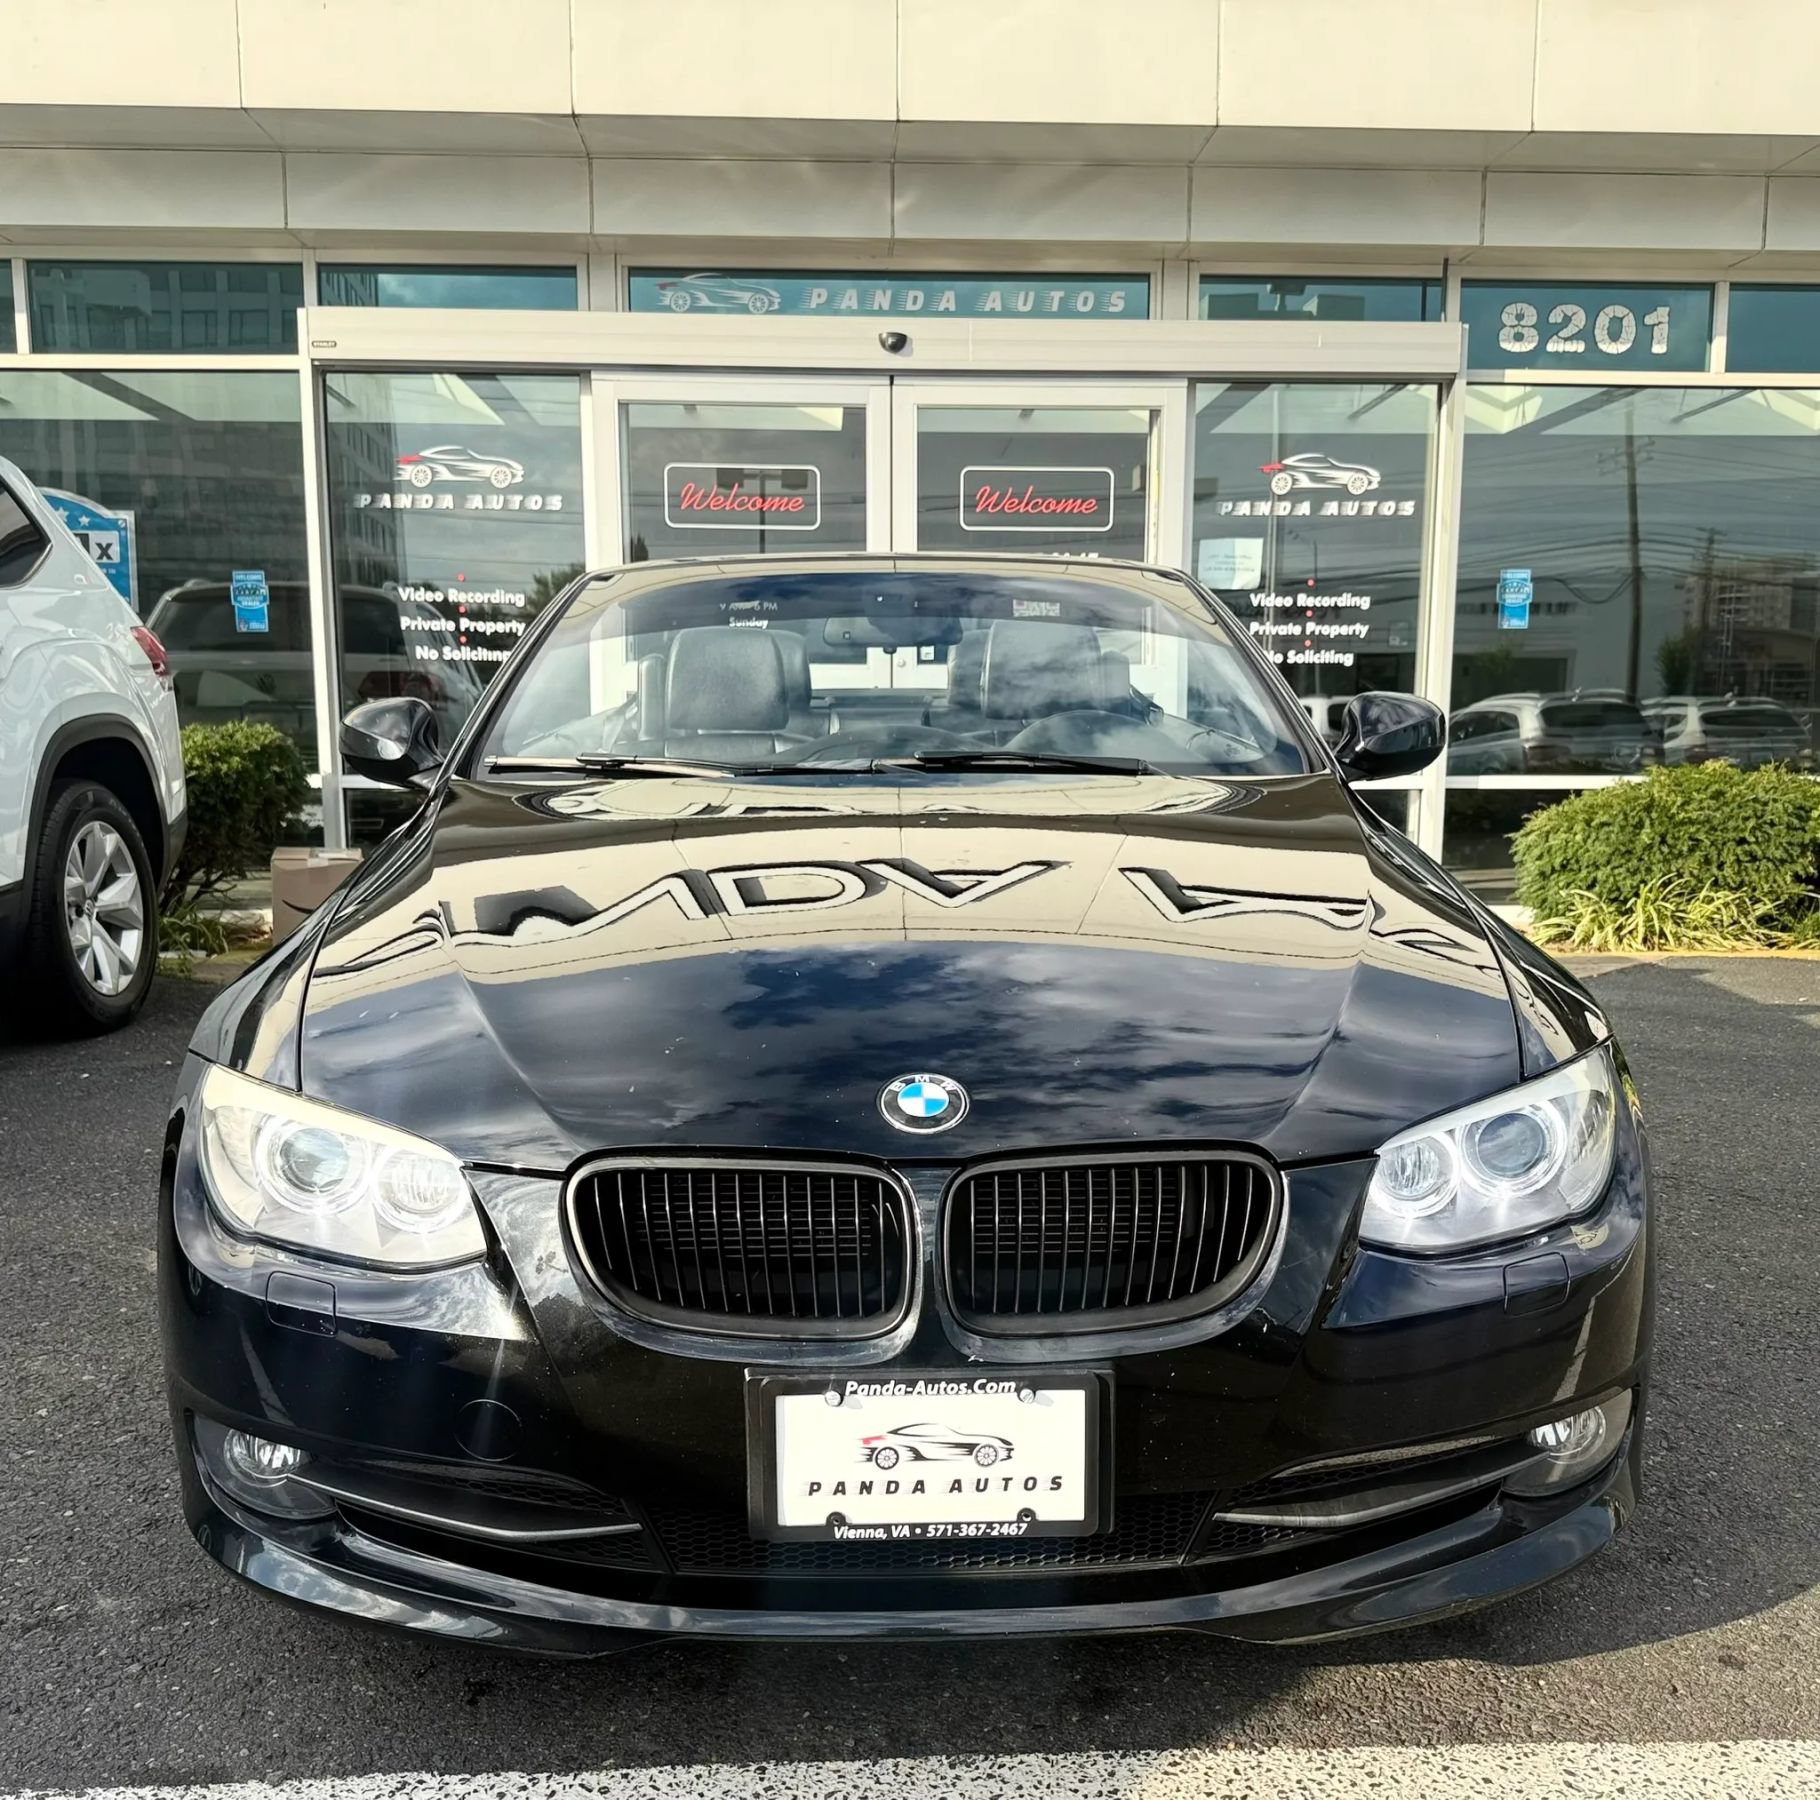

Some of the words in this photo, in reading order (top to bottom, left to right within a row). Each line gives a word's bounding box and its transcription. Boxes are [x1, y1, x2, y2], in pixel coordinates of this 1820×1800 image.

[804, 287, 957, 312] PANDA
[979, 290, 1126, 313] AUTOS
[1498, 302, 1671, 355] 8201
[356, 493, 454, 509] PANDA
[466, 494, 563, 511] AUTOS
[680, 482, 806, 512] Welcome
[975, 484, 1098, 514] Welcome
[1217, 500, 1311, 516] PANDA
[1320, 500, 1416, 516] AUTOS
[397, 586, 445, 603] Video
[447, 588, 526, 608] Recording
[763, 602, 778, 611] PM
[1249, 592, 1294, 608] Video
[1296, 592, 1371, 610] Recording
[400, 615, 457, 632] Private
[459, 617, 527, 637] Property
[728, 616, 769, 630] Sunday
[1249, 622, 1303, 636] Private
[1305, 622, 1370, 639] Property
[415, 645, 440, 660] No
[1286, 650, 1355, 667] Soliciting
[845, 1378, 1017, 1397] Panda-Autos.Com
[806, 1479, 927, 1496] PANDA
[947, 1475, 1064, 1494] AUTOS
[833, 1525, 888, 1541] Vienna,
[890, 1524, 911, 1538] VA
[926, 1522, 1029, 1537] 571-367-2467
